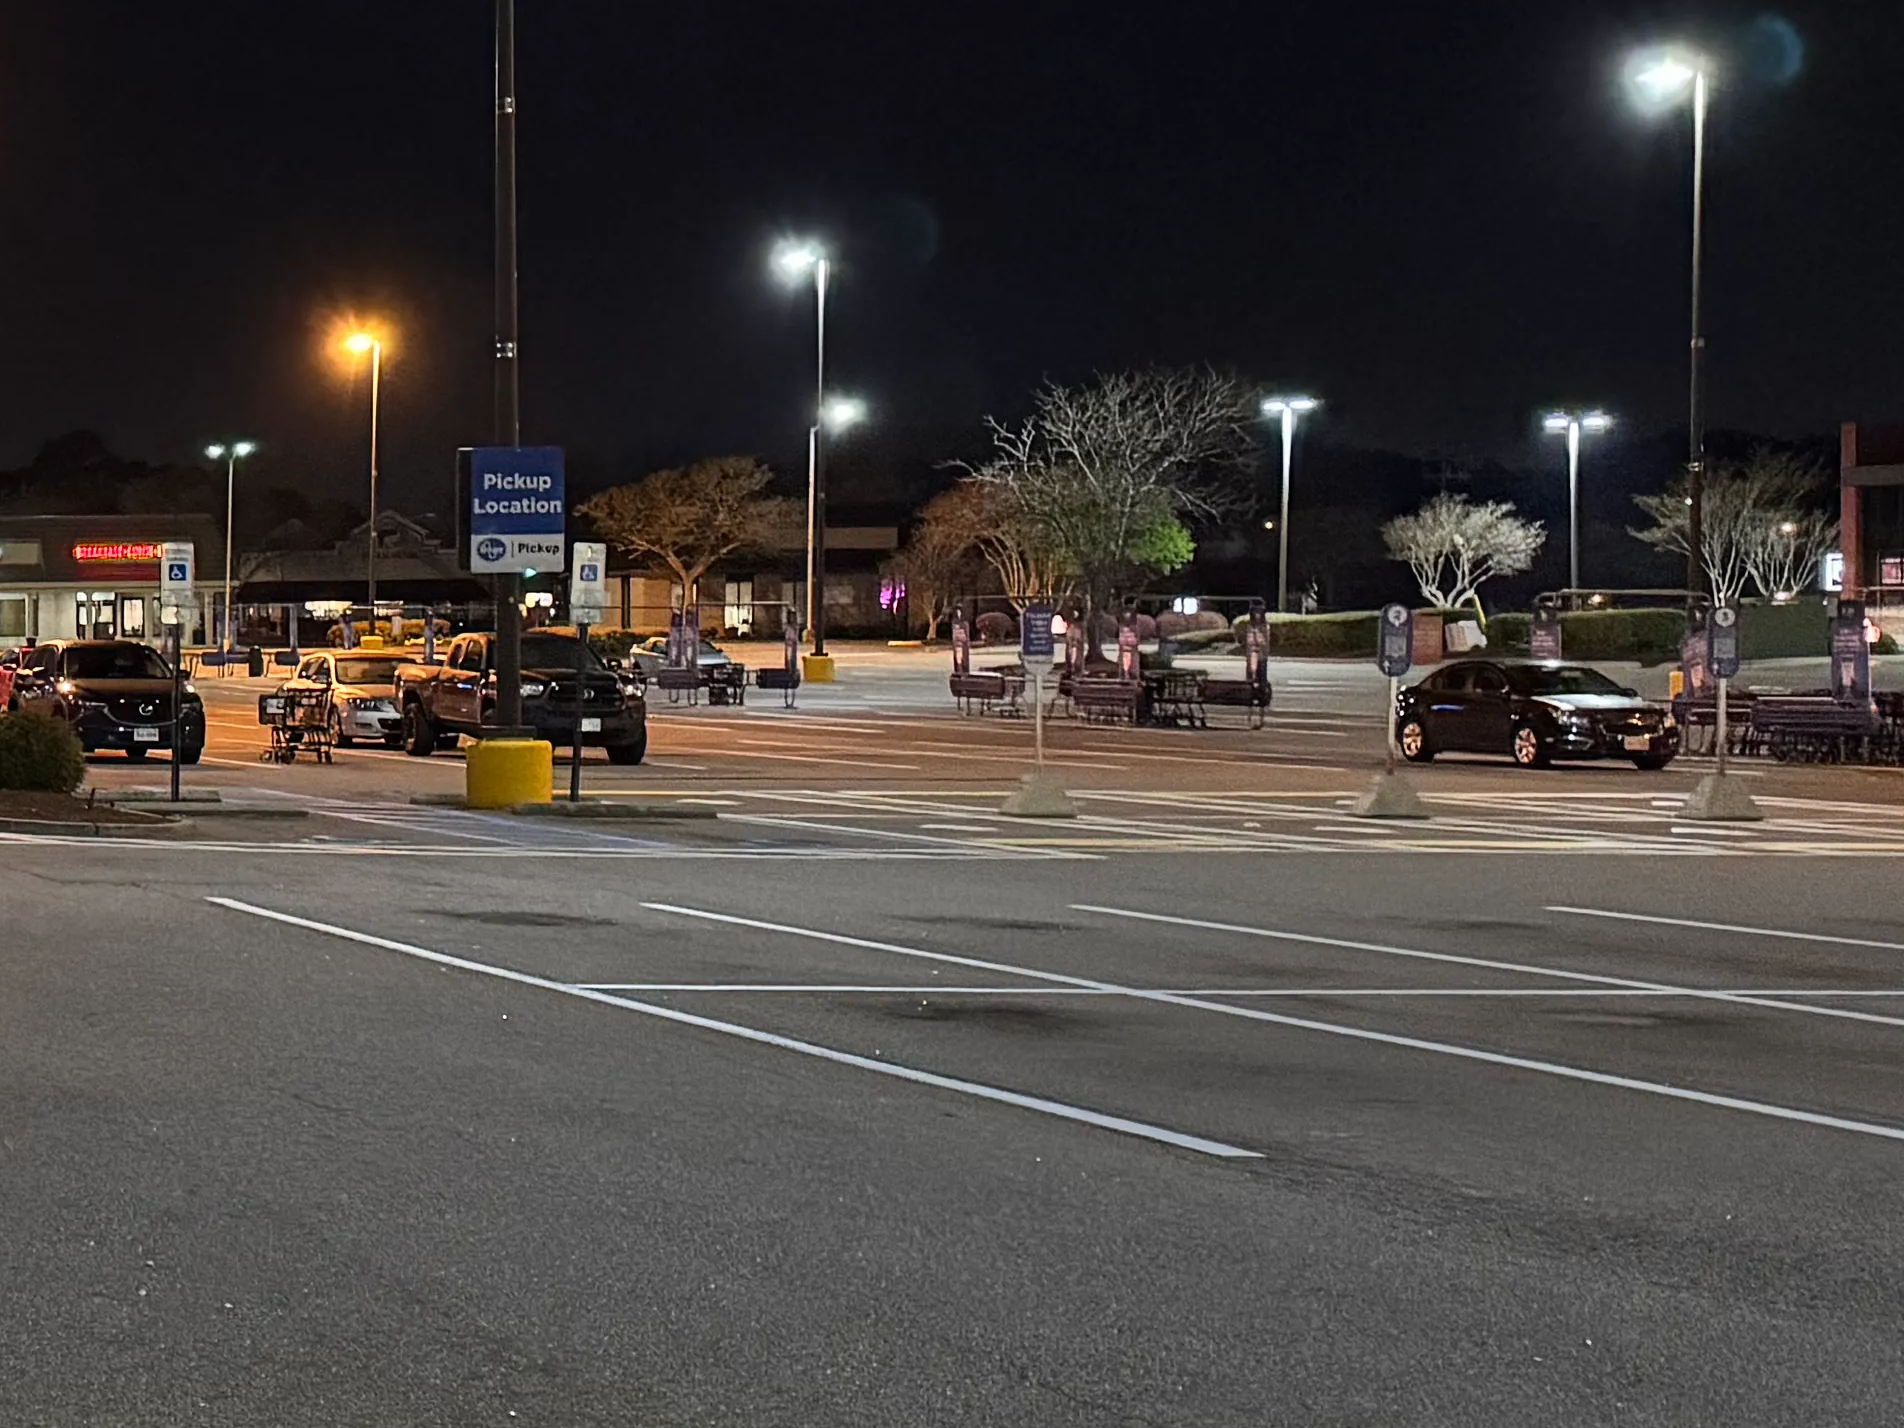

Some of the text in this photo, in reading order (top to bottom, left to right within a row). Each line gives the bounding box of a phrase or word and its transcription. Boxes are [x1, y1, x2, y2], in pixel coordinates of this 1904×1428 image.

[483, 472, 552, 492] Pickup
[473, 496, 562, 515] Location
[518, 542, 560, 555] Pickup
